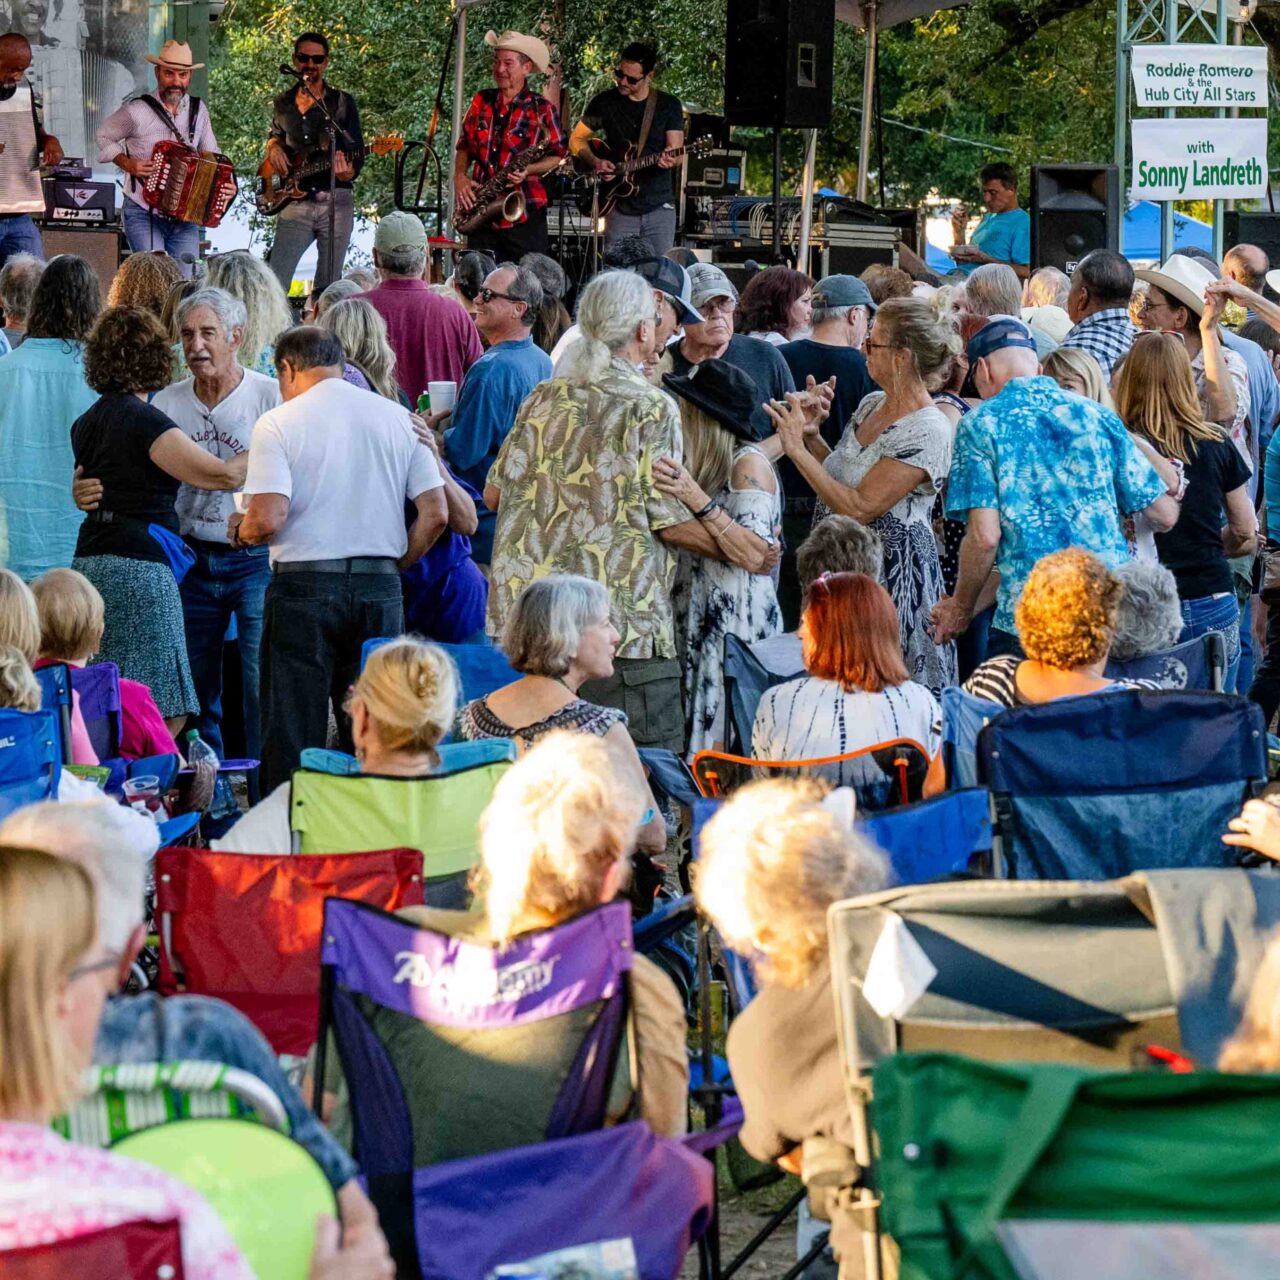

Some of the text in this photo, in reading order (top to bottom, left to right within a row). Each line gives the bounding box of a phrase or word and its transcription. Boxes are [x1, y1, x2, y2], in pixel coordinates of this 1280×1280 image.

[1146, 62, 1253, 77] Roddie Romero
[1188, 78, 1212, 87] & the
[1145, 87, 1256, 104] Hub City All Stars
[1187, 140, 1215, 154] with
[1139, 157, 1262, 194] Sonny Landreth
